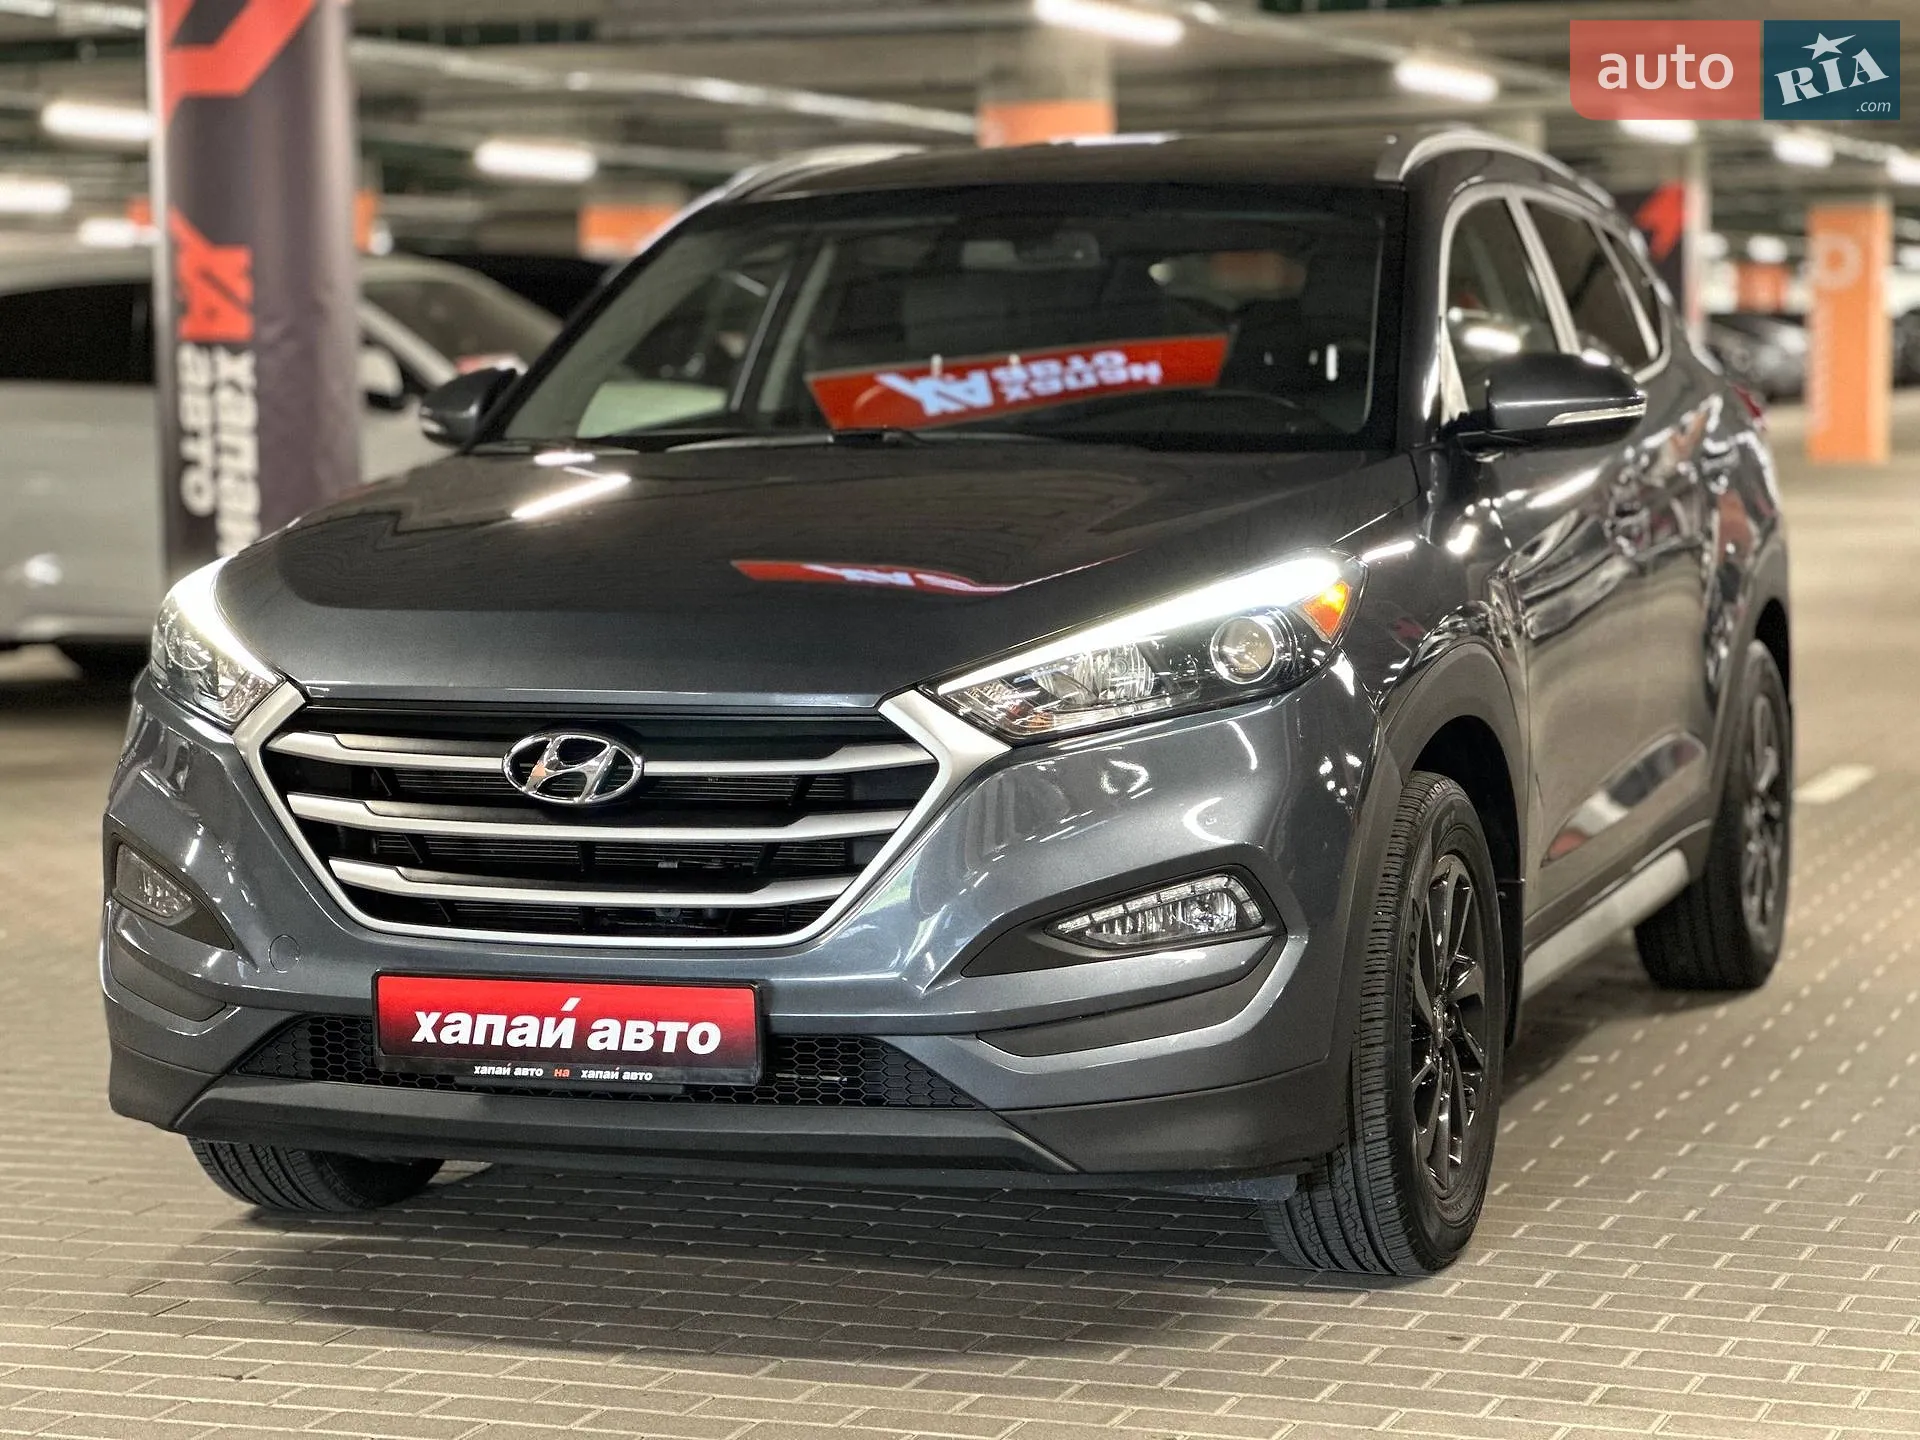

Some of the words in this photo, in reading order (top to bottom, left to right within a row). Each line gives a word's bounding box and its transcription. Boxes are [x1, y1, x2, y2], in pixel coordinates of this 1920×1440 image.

[586, 1018, 722, 1054] авто
[513, 1066, 544, 1077] авто
[553, 1068, 570, 1078] на
[622, 1071, 653, 1081] авто
